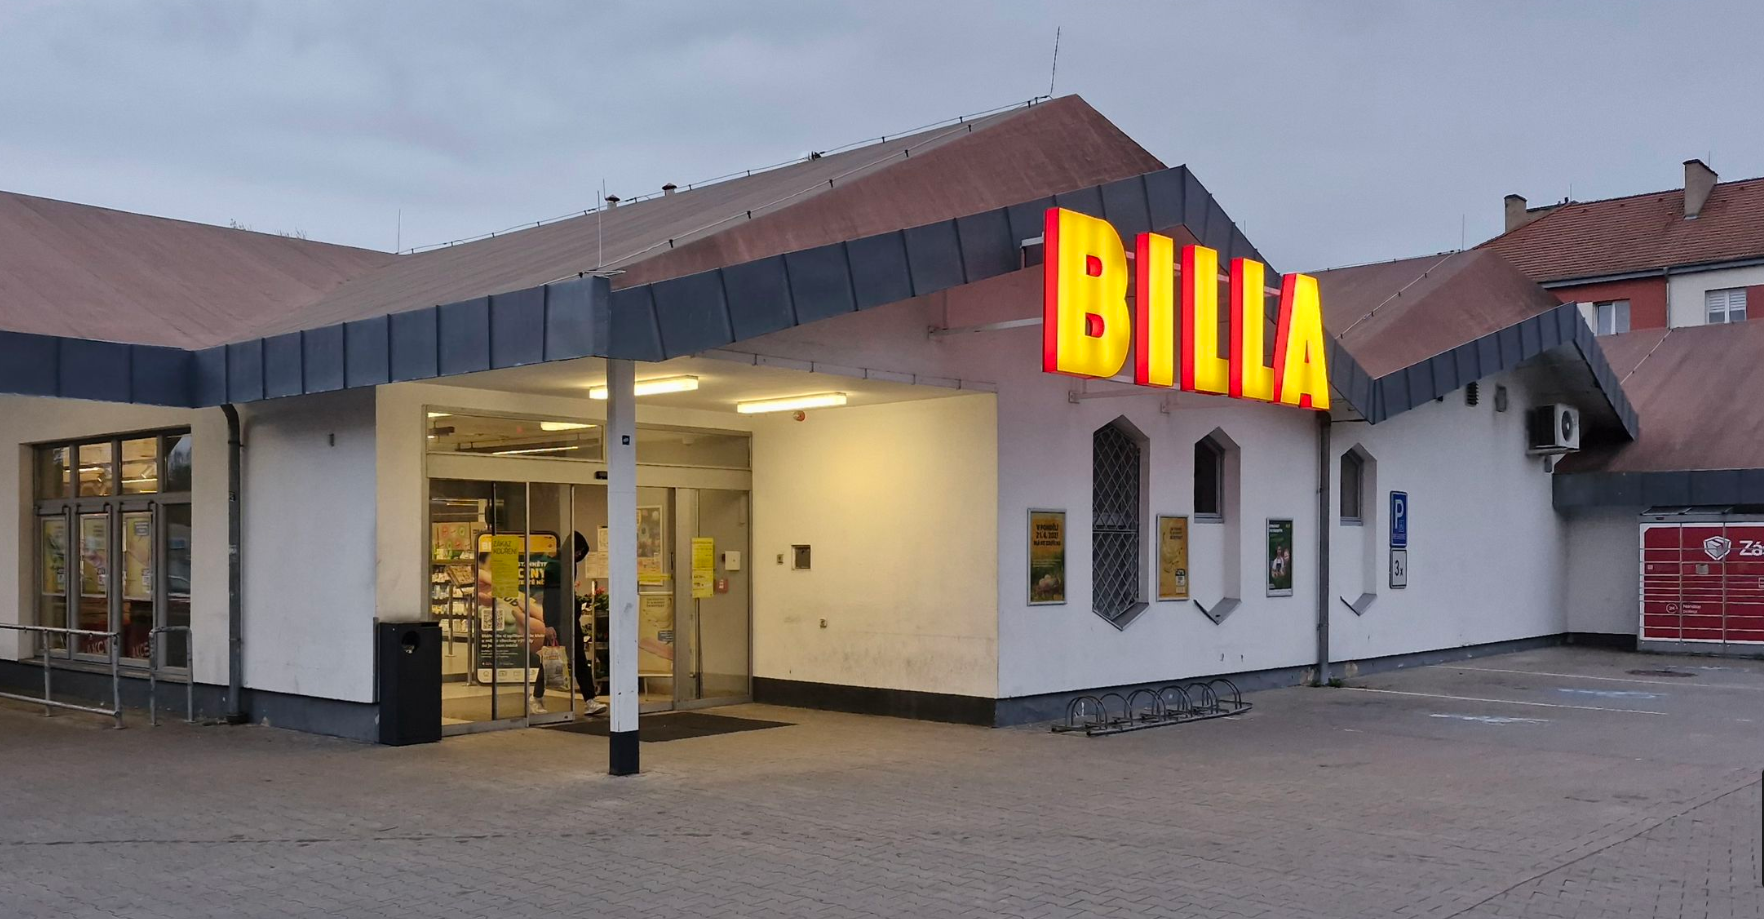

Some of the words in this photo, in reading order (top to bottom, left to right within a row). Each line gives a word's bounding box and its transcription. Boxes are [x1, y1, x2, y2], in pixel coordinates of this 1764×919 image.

[1043, 206, 1330, 410] BILLA
[1395, 498, 1404, 530] P
[518, 568, 545, 579] CNY
